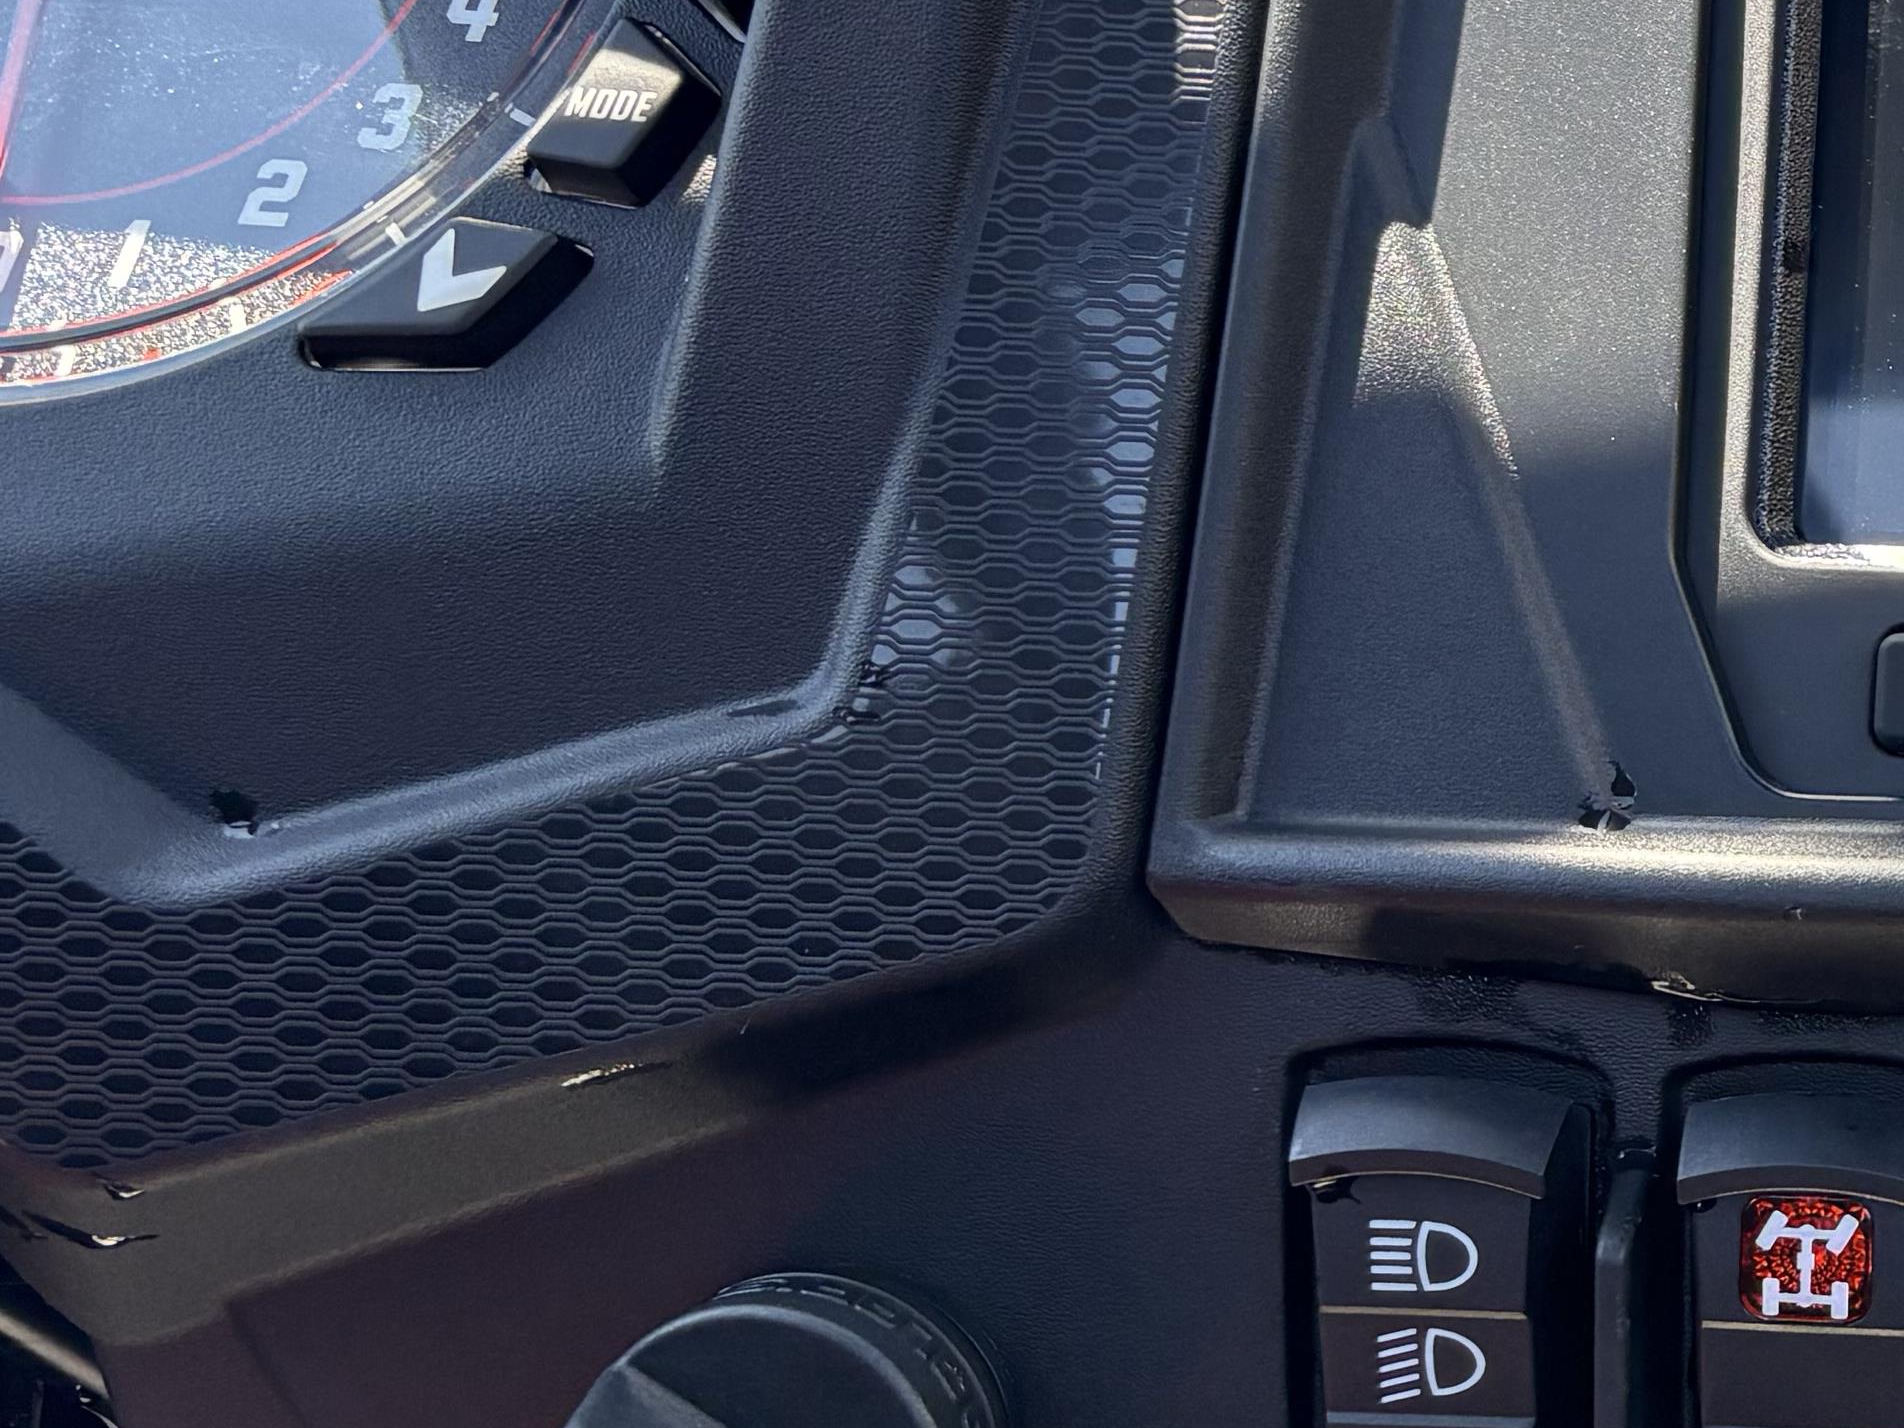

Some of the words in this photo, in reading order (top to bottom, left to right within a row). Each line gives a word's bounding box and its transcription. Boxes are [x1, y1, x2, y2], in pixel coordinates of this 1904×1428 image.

[357, 83, 423, 152] 3
[563, 85, 658, 123] MODE
[238, 158, 308, 227] 2
[107, 219, 152, 289] 1
